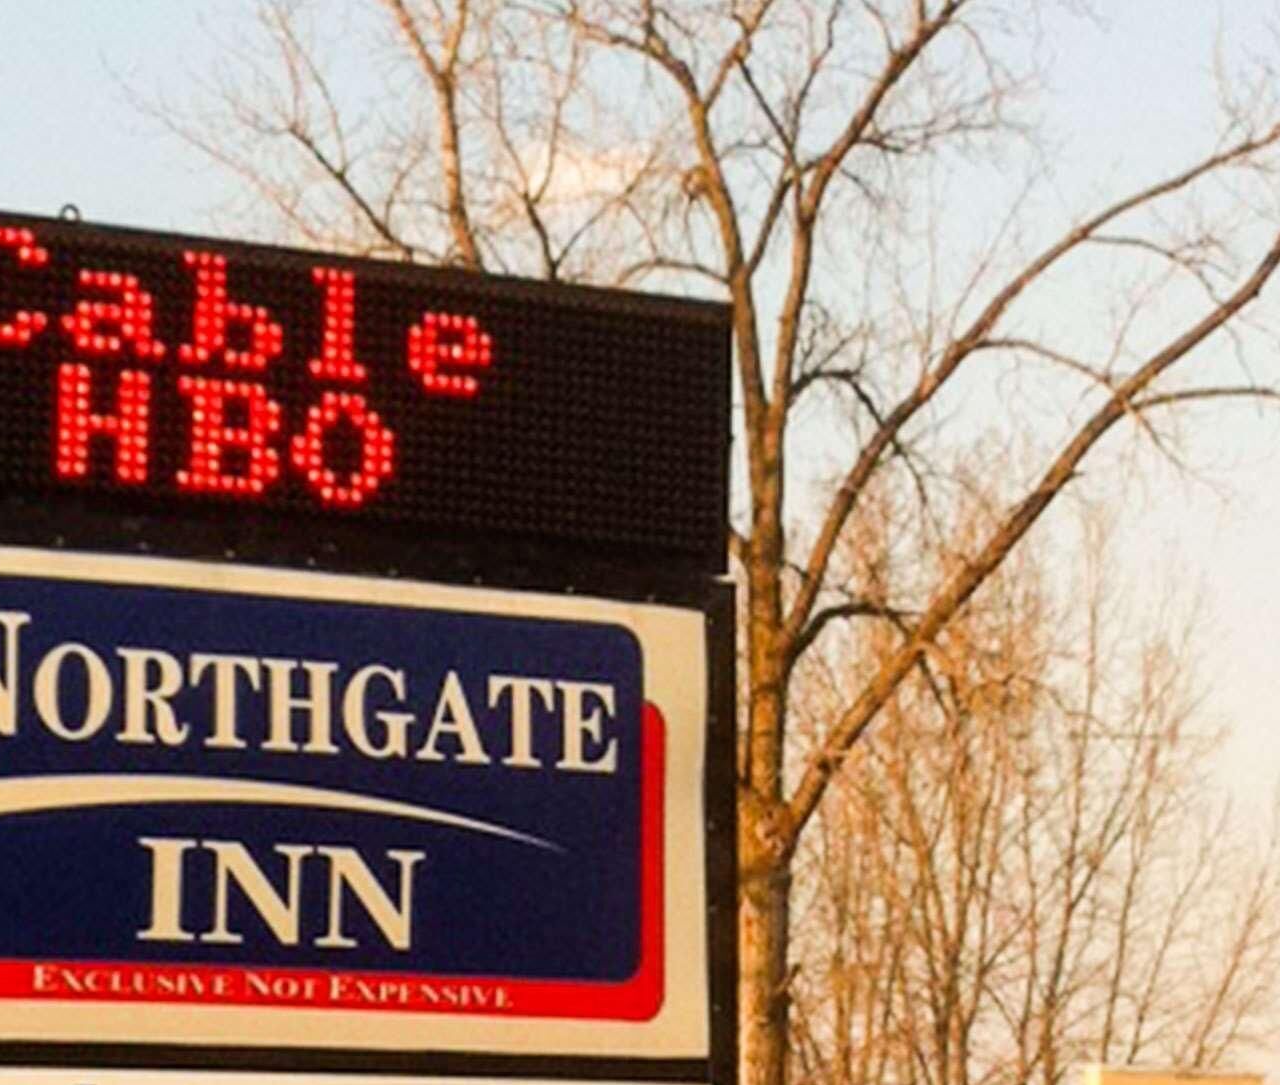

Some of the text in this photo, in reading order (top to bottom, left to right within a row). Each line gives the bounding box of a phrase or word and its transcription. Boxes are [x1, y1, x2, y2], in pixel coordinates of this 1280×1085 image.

[52, 361, 397, 508] HBO
[137, 837, 425, 951] INN
[32, 963, 515, 1010] EXCLUSIVE NOT EXPENSIVE
